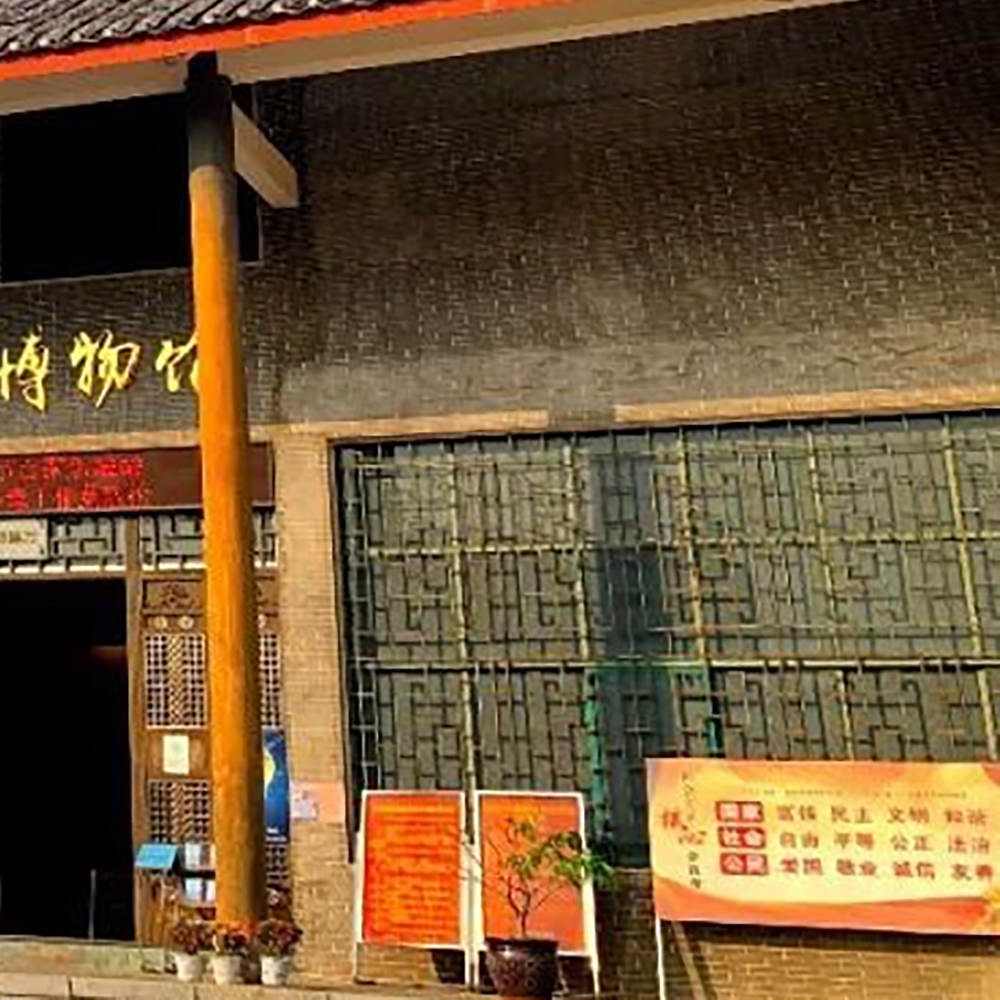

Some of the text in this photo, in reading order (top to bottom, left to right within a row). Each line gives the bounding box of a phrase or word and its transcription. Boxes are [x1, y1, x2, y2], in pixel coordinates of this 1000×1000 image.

[831, 805, 873, 823] 民主
[887, 806, 930, 824] 文明
[780, 831, 819, 849] 自由
[890, 833, 932, 851] 公正
